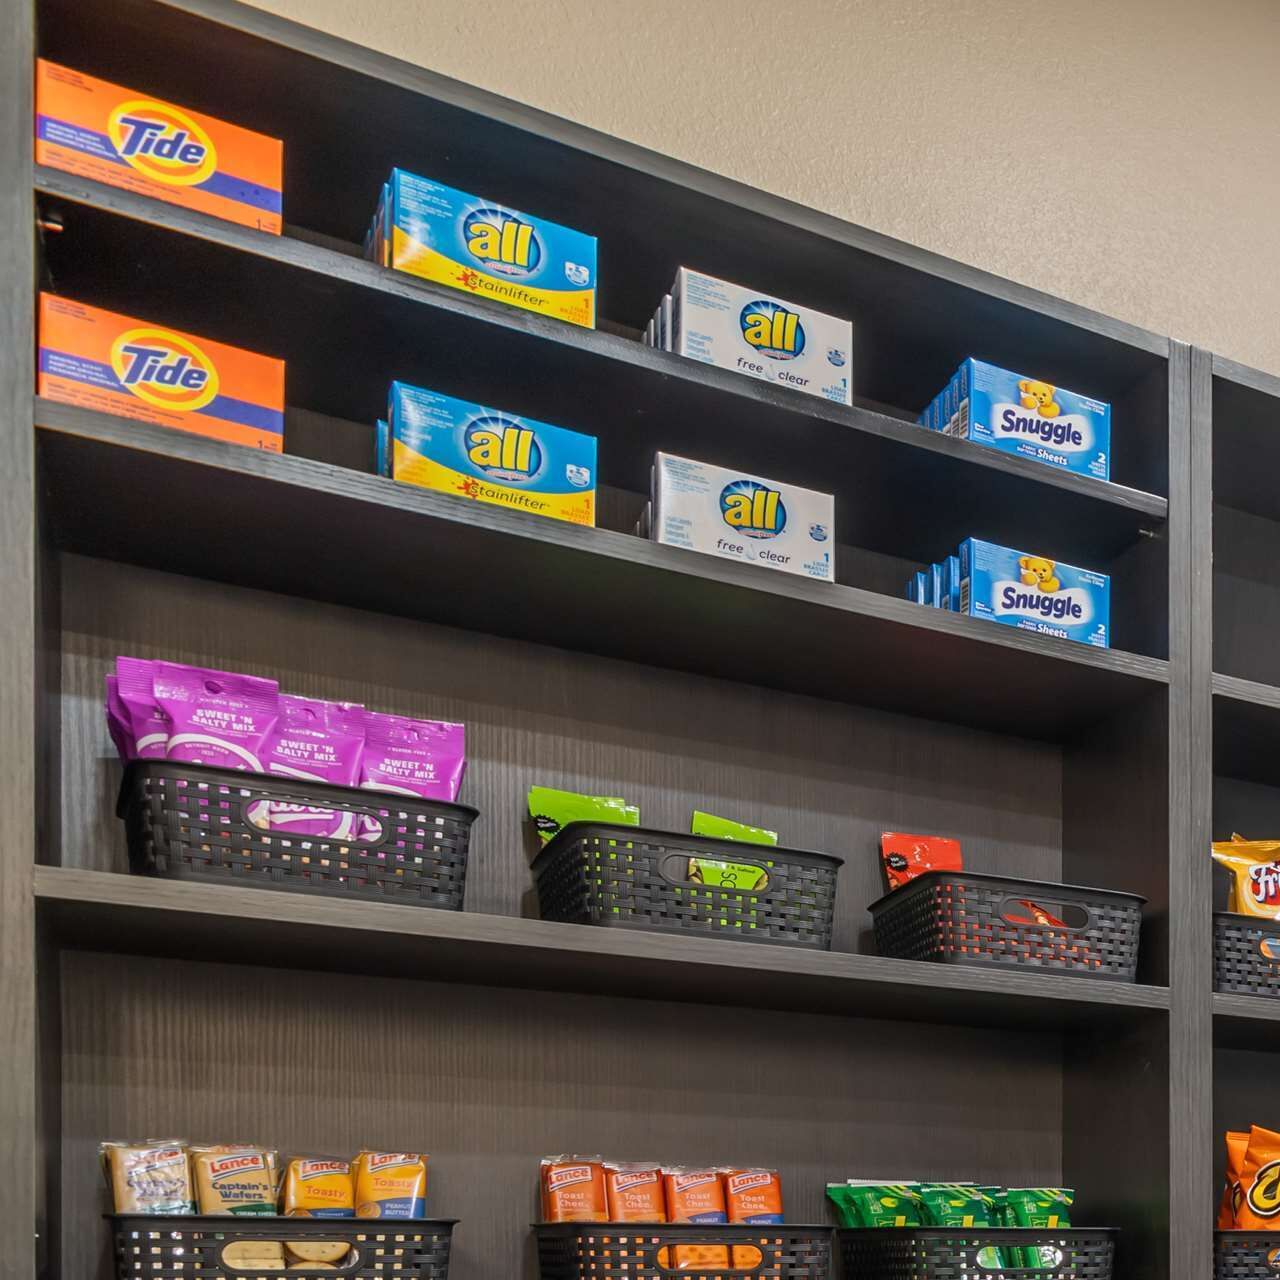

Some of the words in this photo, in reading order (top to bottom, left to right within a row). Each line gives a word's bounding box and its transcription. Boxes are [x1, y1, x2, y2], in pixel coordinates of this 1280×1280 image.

[119, 115, 206, 164] Tide
[467, 220, 534, 267] all
[469, 276, 544, 306] stainlifter
[744, 311, 800, 352] all
[121, 345, 208, 390] Tide
[736, 357, 763, 373] free
[778, 370, 809, 387] clear
[1001, 409, 1083, 445] Snuggle
[468, 427, 534, 473] all
[1037, 449, 1067, 466] Sheets
[1098, 452, 1106, 463] 2
[470, 484, 545, 510] stainlifter
[723, 490, 781, 530] all
[716, 539, 744, 554] free
[759, 550, 791, 564] clear
[1002, 587, 1082, 619] Snuggle
[1037, 623, 1068, 638] Sheets
[1098, 624, 1105, 634] 2
[192, 715, 227, 729] SALTY
[232, 723, 256, 732] MIX
[196, 708, 236, 722] SWEET
[240, 716, 253, 724] 'N
[276, 746, 309, 759] SALTY
[314, 752, 336, 762] MIX
[280, 739, 318, 752] SWEET
[322, 745, 334, 754] 'N
[379, 764, 411, 777] SALTY
[415, 771, 436, 780] MIX
[383, 758, 419, 770] SWEET
[423, 763, 434, 771] 'N
[209, 1157, 260, 1174] Lance
[302, 1161, 347, 1174] Lance
[374, 1178, 414, 1188] Toasty
[550, 1169, 589, 1185] Lance
[616, 1171, 654, 1185] Lance
[731, 1174, 769, 1188] Lance
[212, 1182, 268, 1191] Captain's
[306, 1186, 344, 1198] Toasty
[220, 1190, 264, 1200] Wafers
[559, 1191, 584, 1199] Toast
[624, 1192, 651, 1200] Toast
